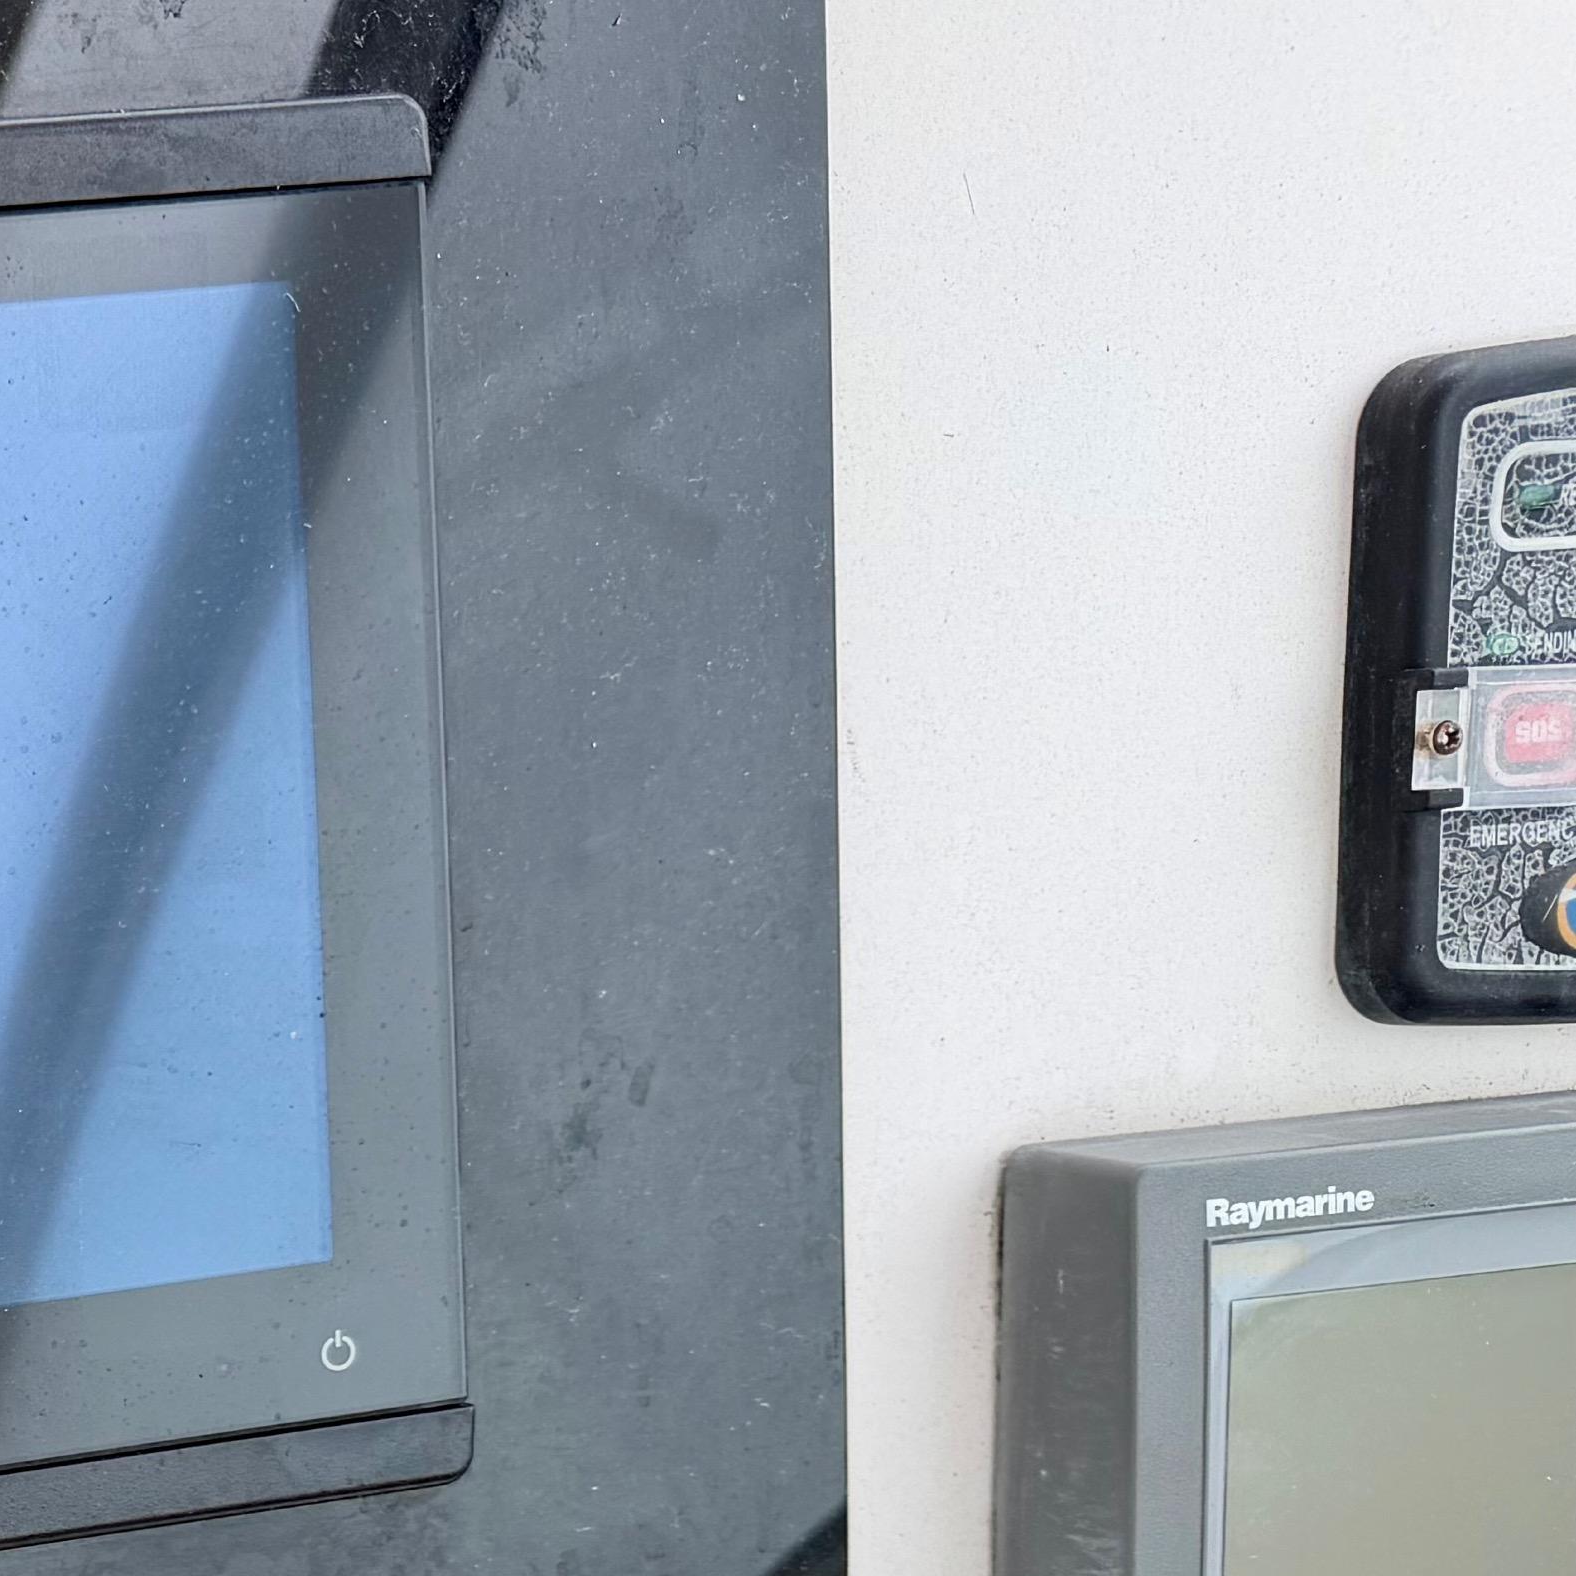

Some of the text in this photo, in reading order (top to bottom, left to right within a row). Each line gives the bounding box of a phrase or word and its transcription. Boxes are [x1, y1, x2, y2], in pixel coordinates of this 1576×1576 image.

[1523, 628, 1576, 656] SENDIN
[1515, 720, 1563, 745] SOS
[1469, 818, 1576, 848] EMERGENC
[1206, 1186, 1375, 1229] Raymarine
